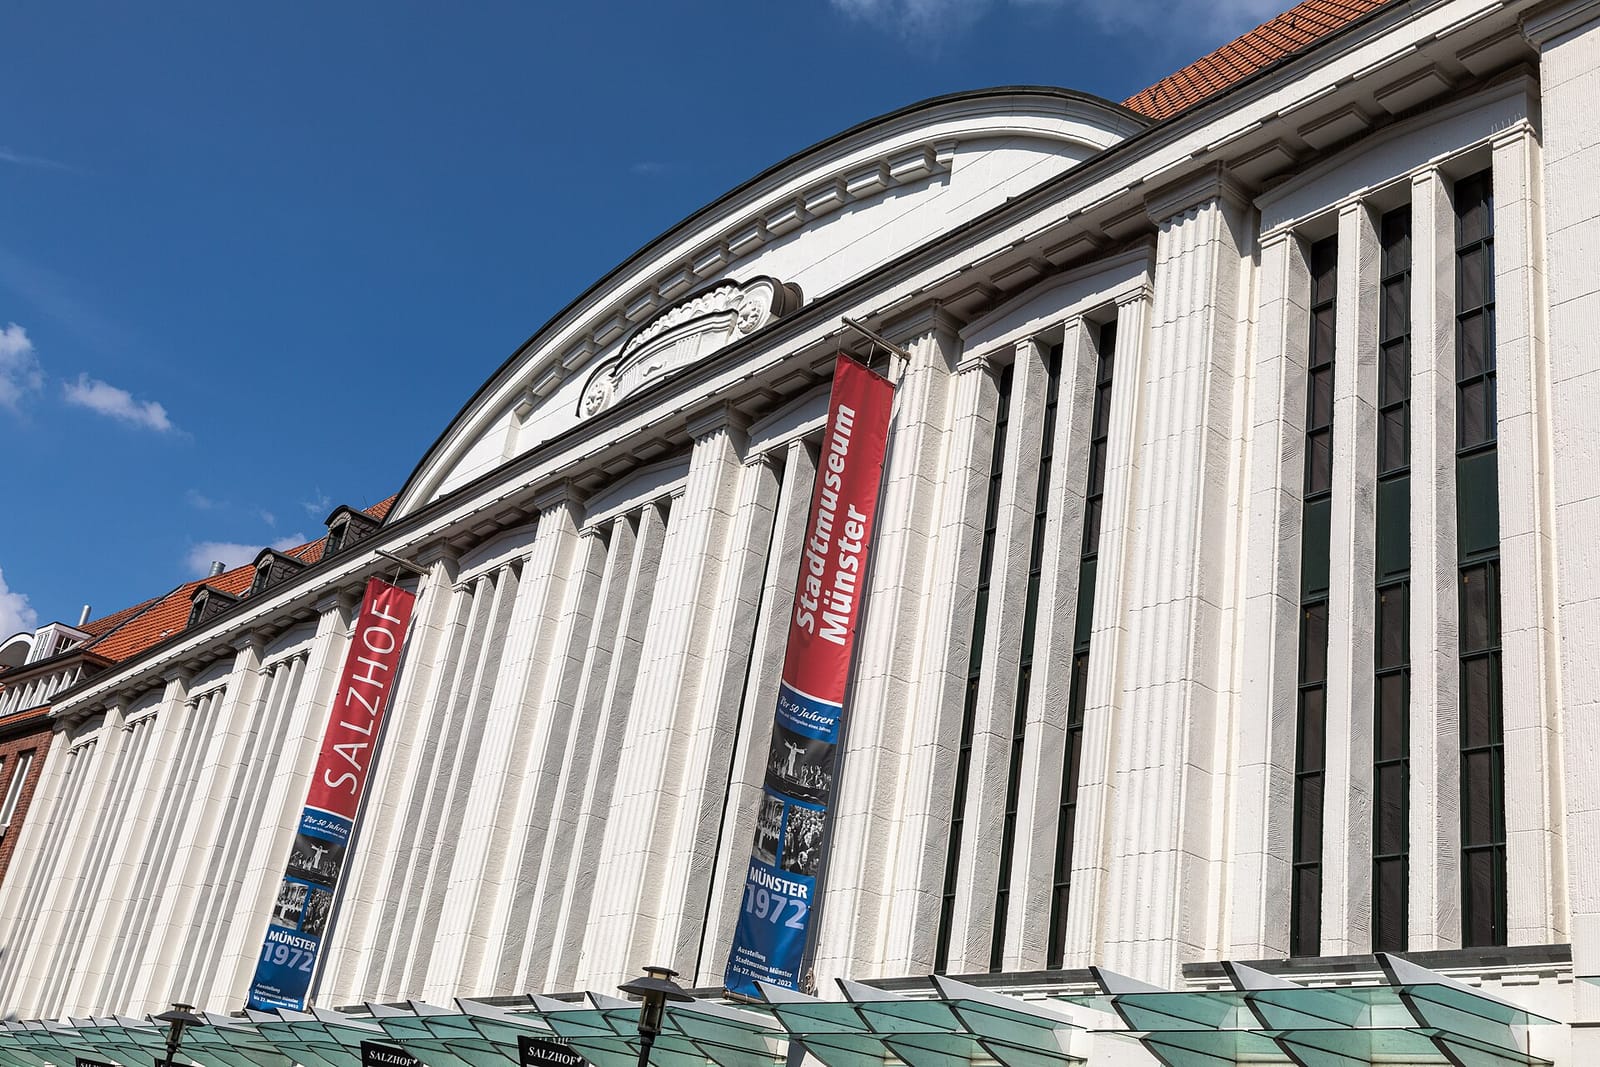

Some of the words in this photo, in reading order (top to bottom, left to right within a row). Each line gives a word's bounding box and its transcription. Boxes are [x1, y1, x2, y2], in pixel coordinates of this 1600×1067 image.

[795, 403, 856, 634] Stadtmuseum
[818, 503, 867, 646] Münster
[323, 598, 402, 795] SALZHOF
[790, 704, 799, 712] 50
[798, 707, 835, 725] Jahren
[750, 866, 809, 900] MÜNSTER
[746, 882, 807, 931] 1972
[268, 931, 316, 952] MÜNSTER
[262, 942, 315, 974] 1972
[738, 946, 766, 962] Ausstellung
[736, 956, 768, 971] Stadtmuseum
[768, 966, 792, 977] Münster
[750, 970, 776, 984] November
[778, 980, 792, 988] 2022
[368, 1049, 414, 1067] SALZHOF
[527, 1045, 577, 1066] SALZHOF
